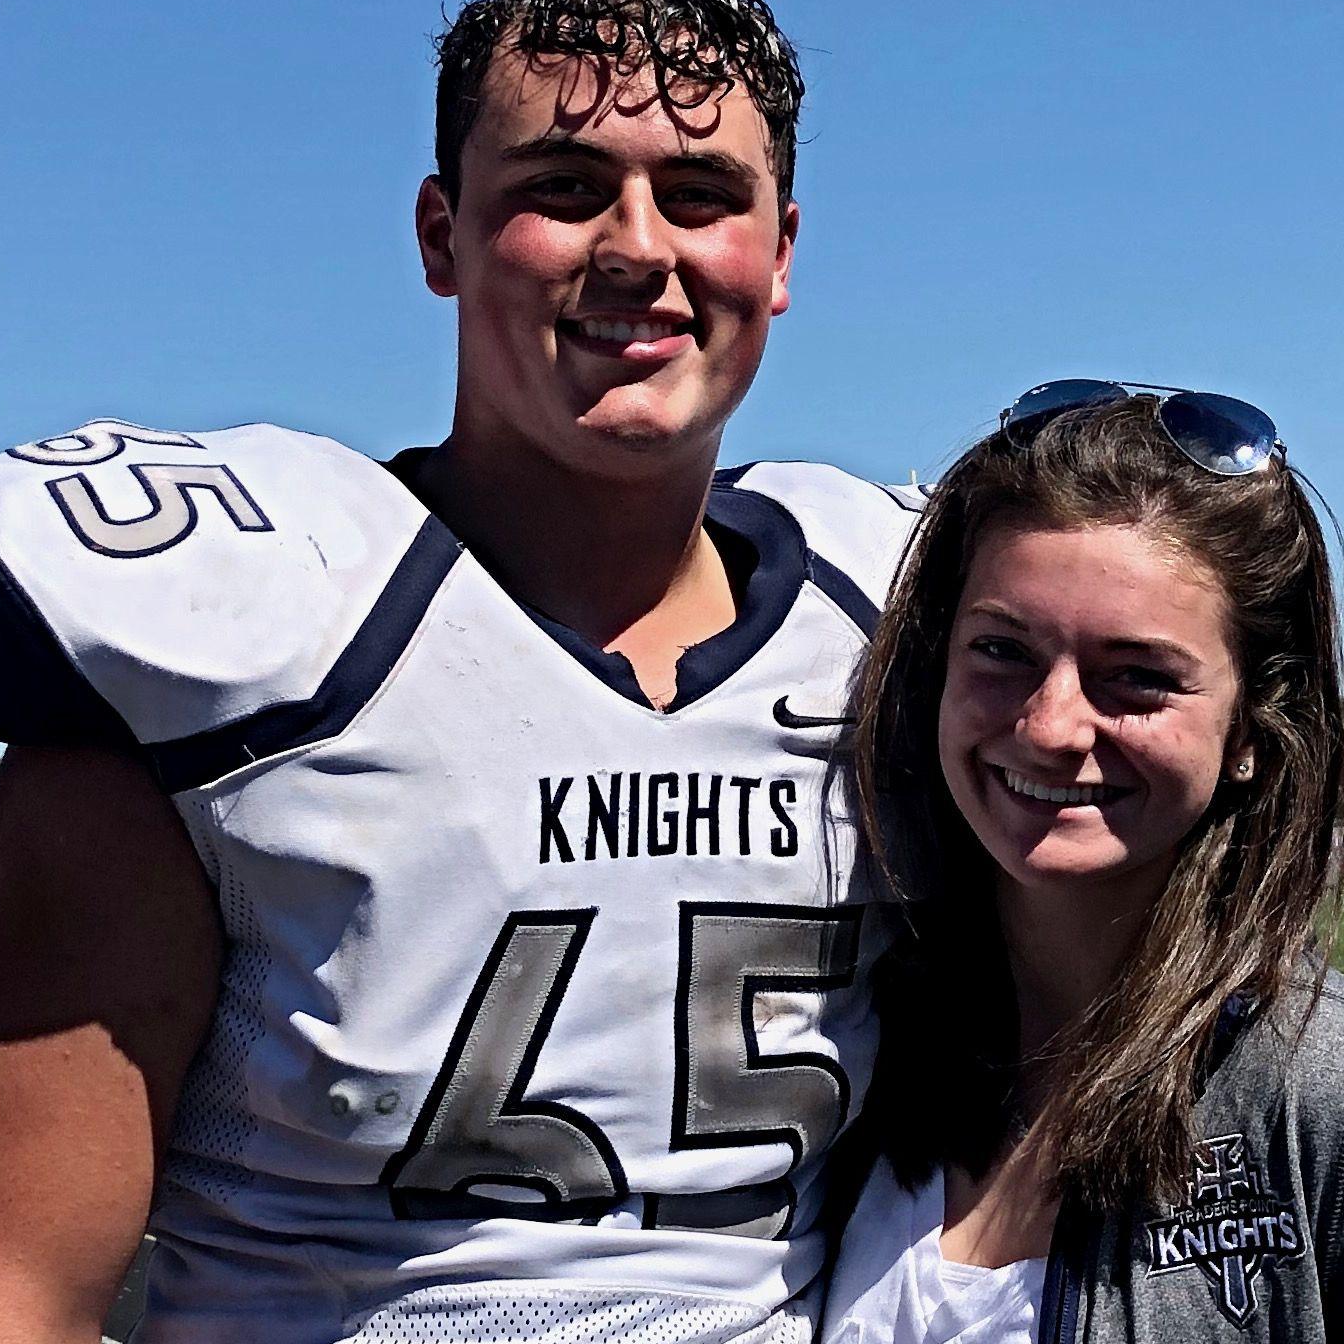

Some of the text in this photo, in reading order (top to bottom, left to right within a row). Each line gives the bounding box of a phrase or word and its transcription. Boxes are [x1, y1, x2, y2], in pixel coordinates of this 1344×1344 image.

[538, 770, 799, 865] KNIGHTS
[379, 900, 865, 1242] 65
[1156, 1211, 1298, 1265] KNIGHTS
[1175, 1200, 1238, 1225] TRADERS
